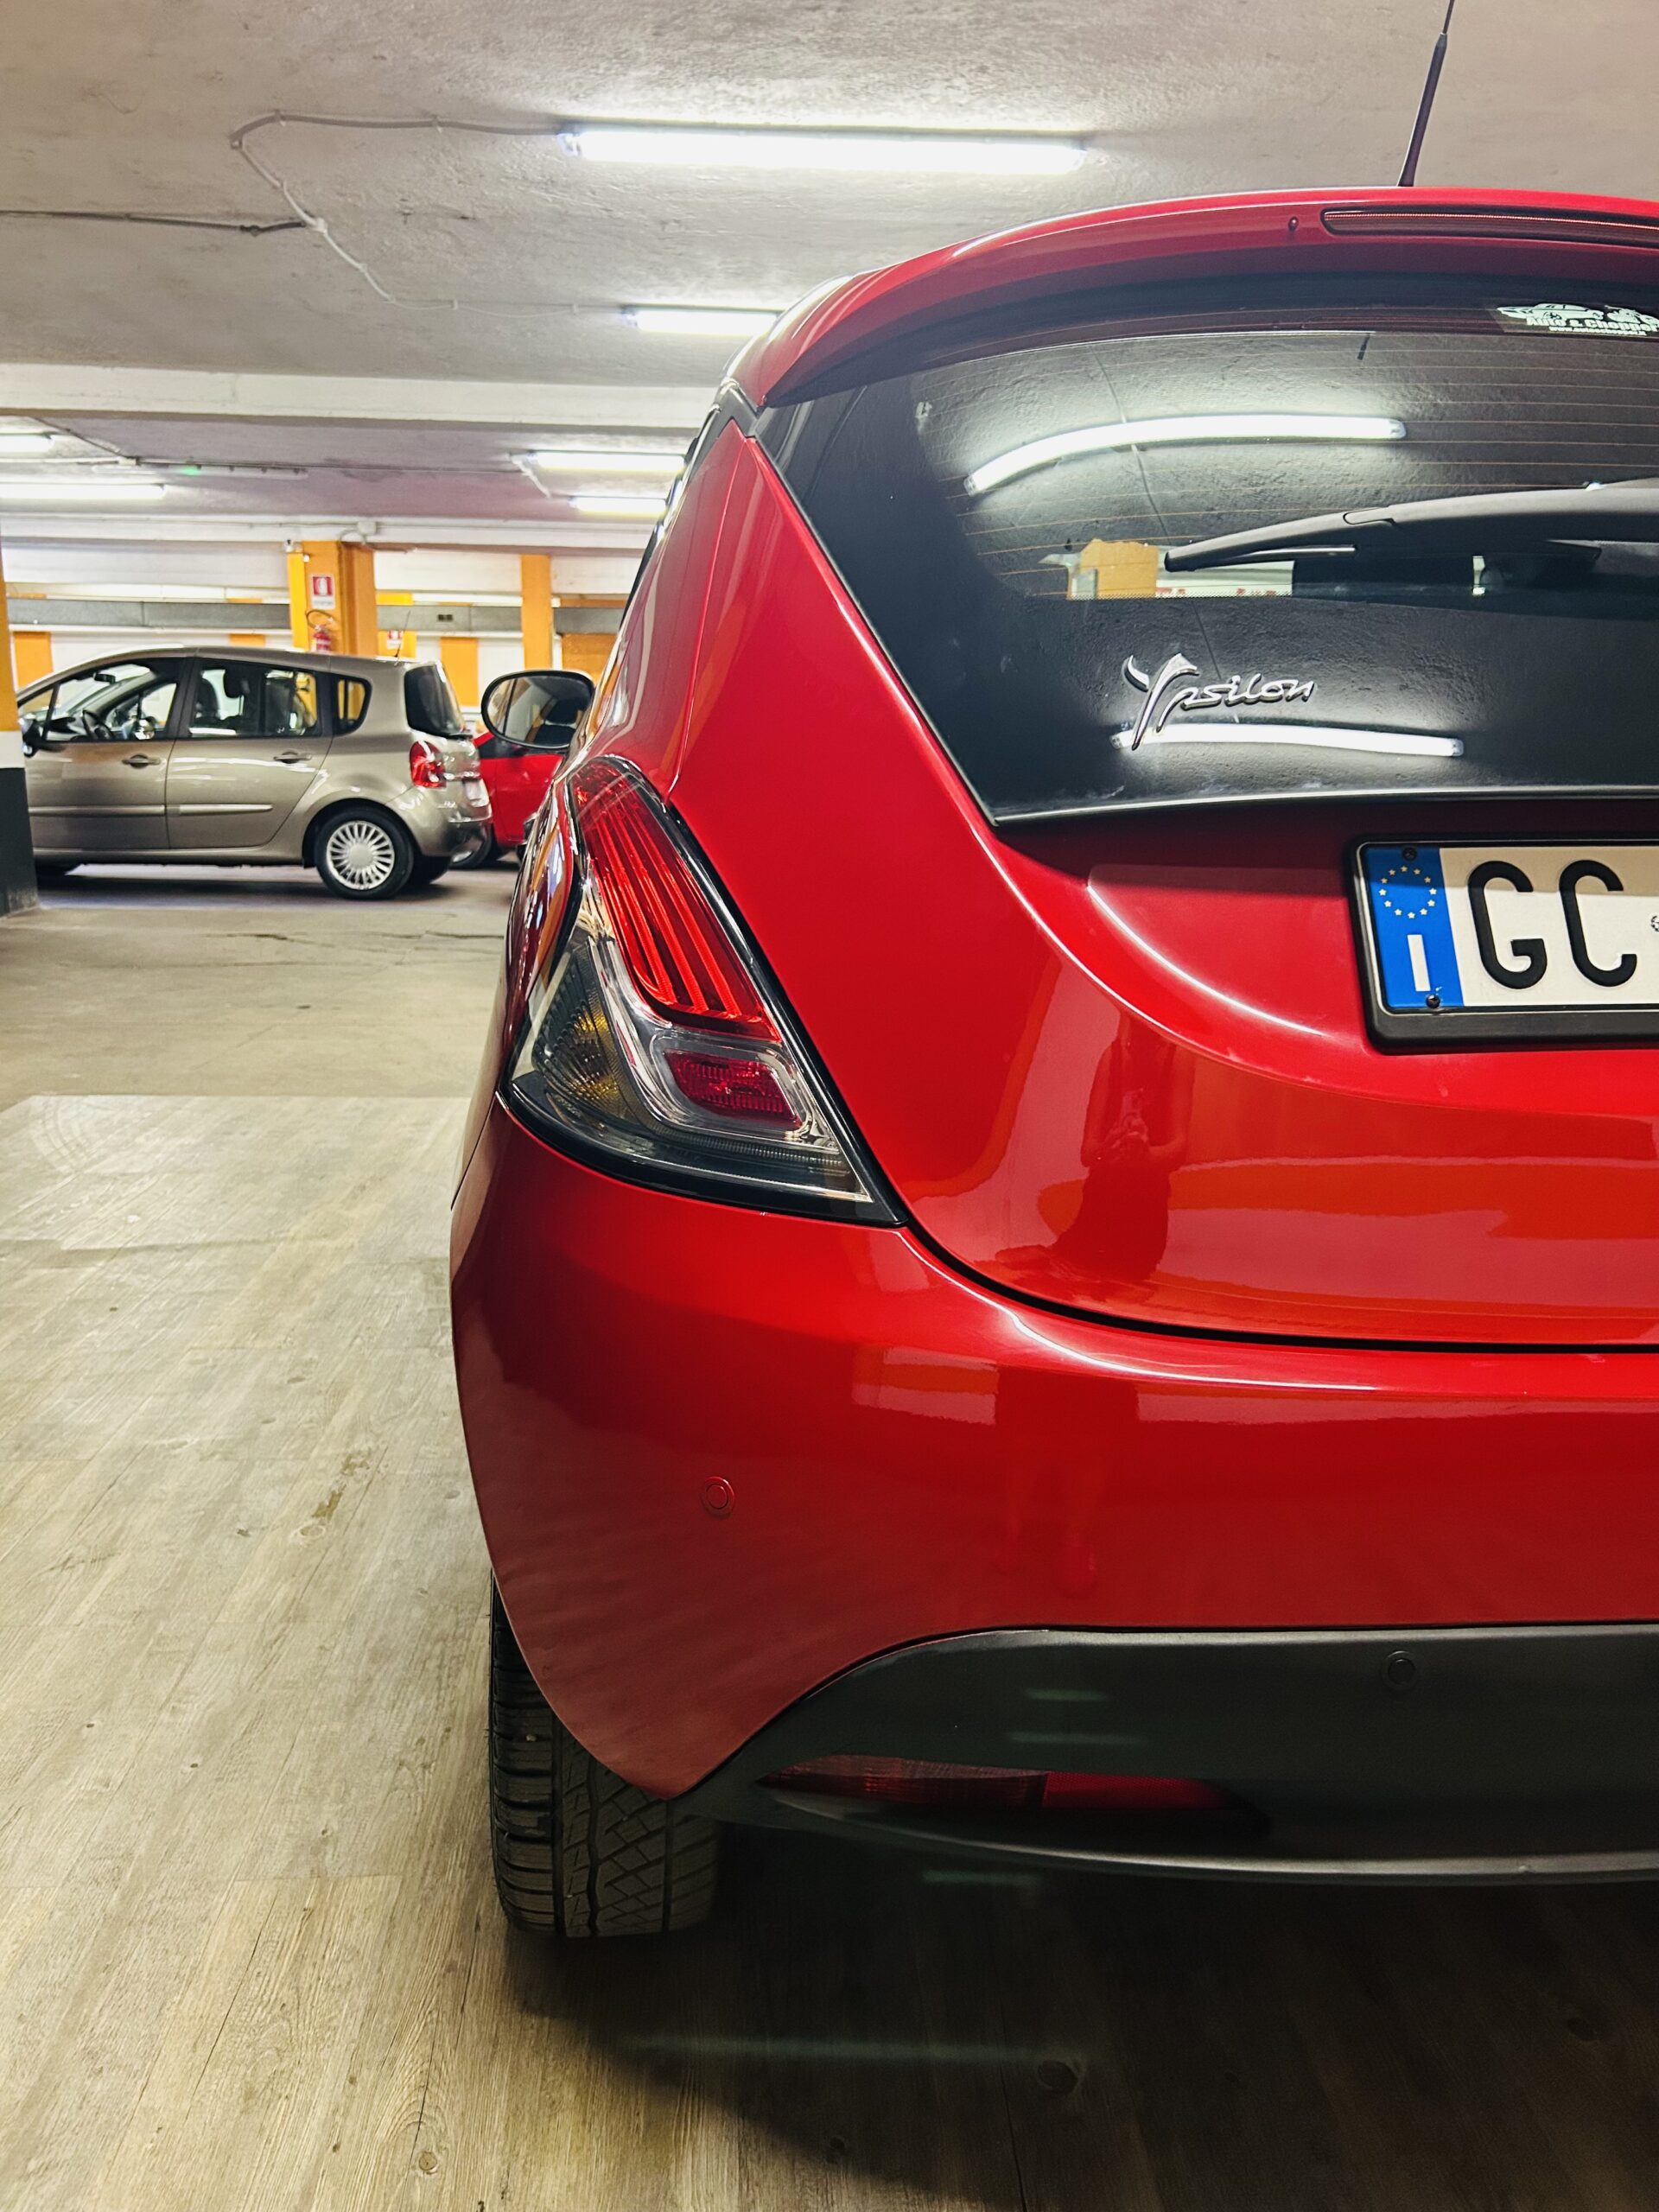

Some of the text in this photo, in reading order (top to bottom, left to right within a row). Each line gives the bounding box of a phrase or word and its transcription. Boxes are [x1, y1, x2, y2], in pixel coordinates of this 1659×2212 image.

[1526, 316, 1567, 327] Auto
[1123, 652, 1316, 751] Ypsilon
[1407, 860, 1637, 992] I GC
